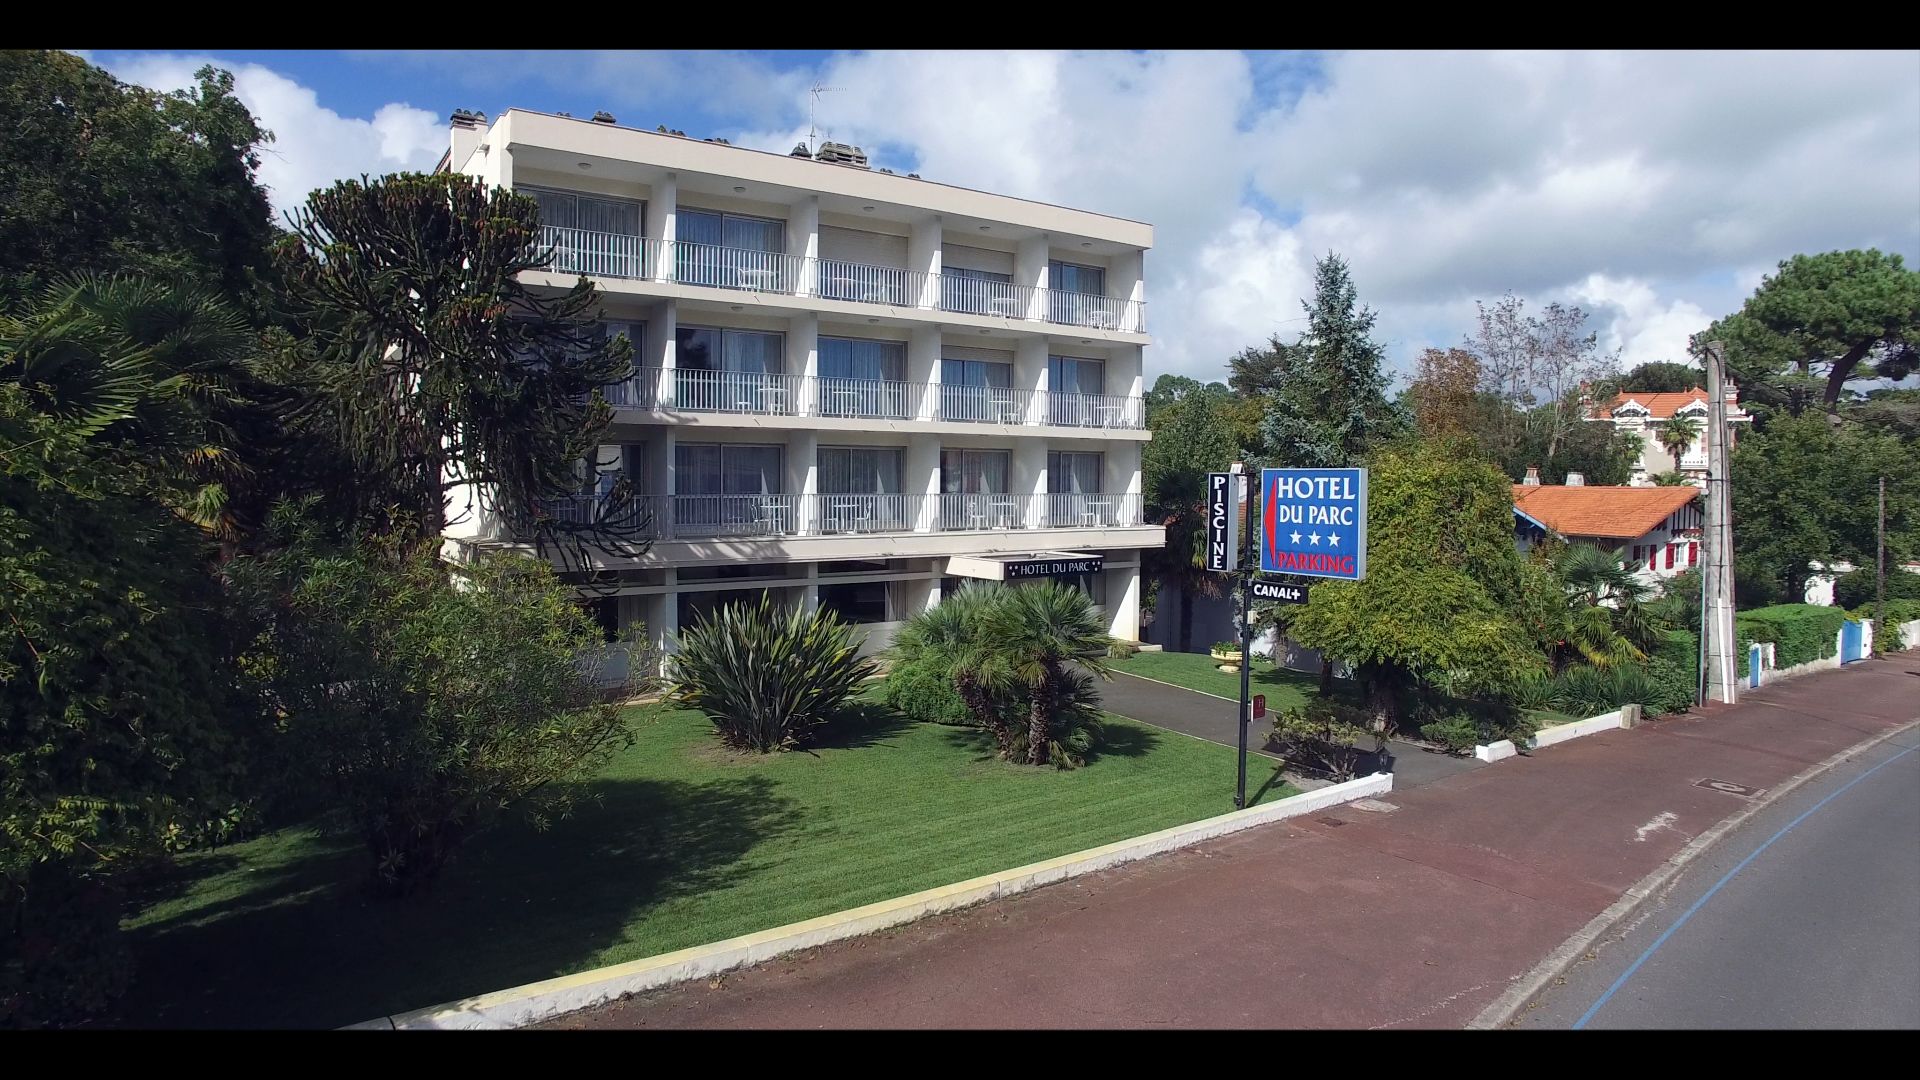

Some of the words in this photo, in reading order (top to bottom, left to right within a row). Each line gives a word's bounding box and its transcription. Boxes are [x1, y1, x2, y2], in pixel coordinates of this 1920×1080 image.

[1278, 477, 1356, 500] HOTEL
[1213, 476, 1226, 569] PISCINE
[1279, 505, 1303, 524] DU
[1308, 506, 1353, 526] PARC
[1020, 564, 1050, 575] HOTEL
[1053, 563, 1066, 574] DU
[1069, 561, 1090, 573] PARC
[1278, 551, 1354, 574] PARKING
[1253, 583, 1301, 601] CANAL+
